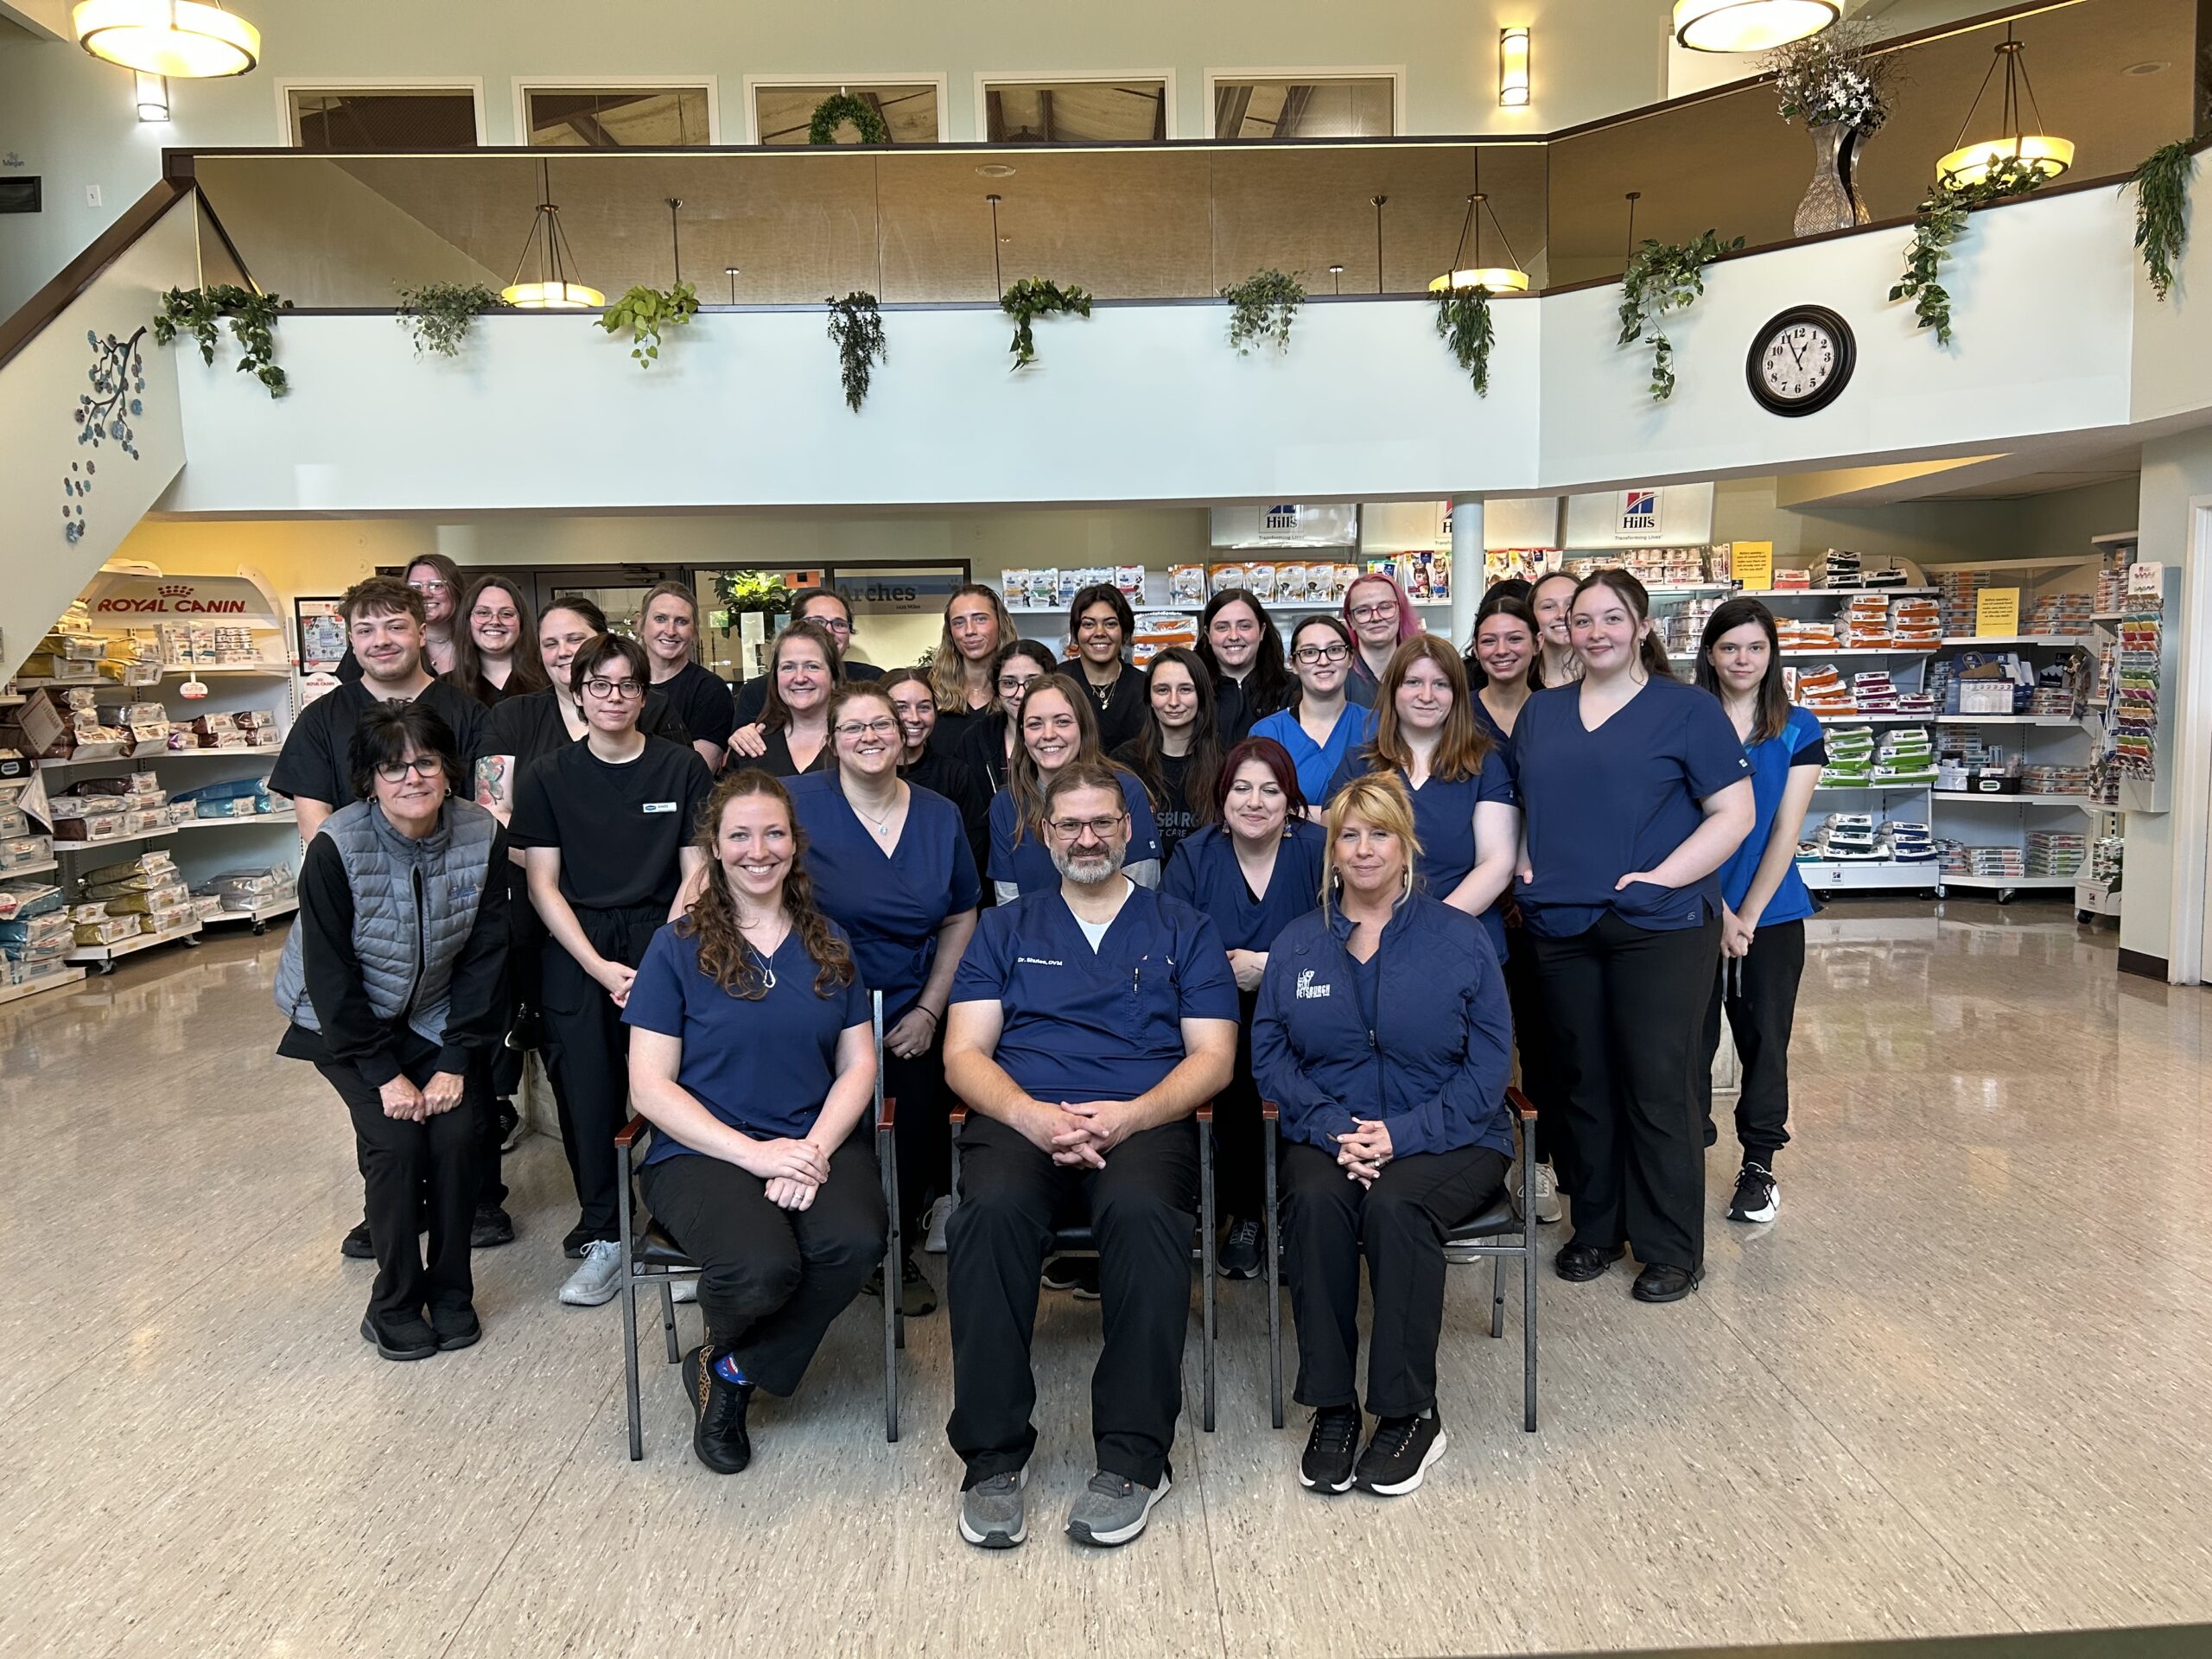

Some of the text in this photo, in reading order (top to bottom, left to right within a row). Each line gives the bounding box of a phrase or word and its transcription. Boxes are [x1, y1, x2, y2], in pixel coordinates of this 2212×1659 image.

[1794, 327, 1806, 339] 12
[1812, 330, 1817, 340] 1
[1781, 334, 1791, 345] 11
[1821, 339, 1827, 349] 2
[1772, 346, 1783, 356] 10
[1824, 353, 1831, 362] 3
[1767, 360, 1774, 370] 9
[1818, 366, 1826, 376] 4
[1770, 373, 1778, 383] 8
[1809, 378, 1816, 388] 5
[1781, 382, 1788, 391] 7
[1795, 384, 1802, 394] 6
[1266, 516, 1298, 529] Hill's
[1623, 516, 1656, 529] Hill's
[839, 582, 916, 601] Arches
[98, 598, 169, 613] ROYAL
[175, 600, 245, 613] CANIN
[1166, 829, 1187, 837] CARE
